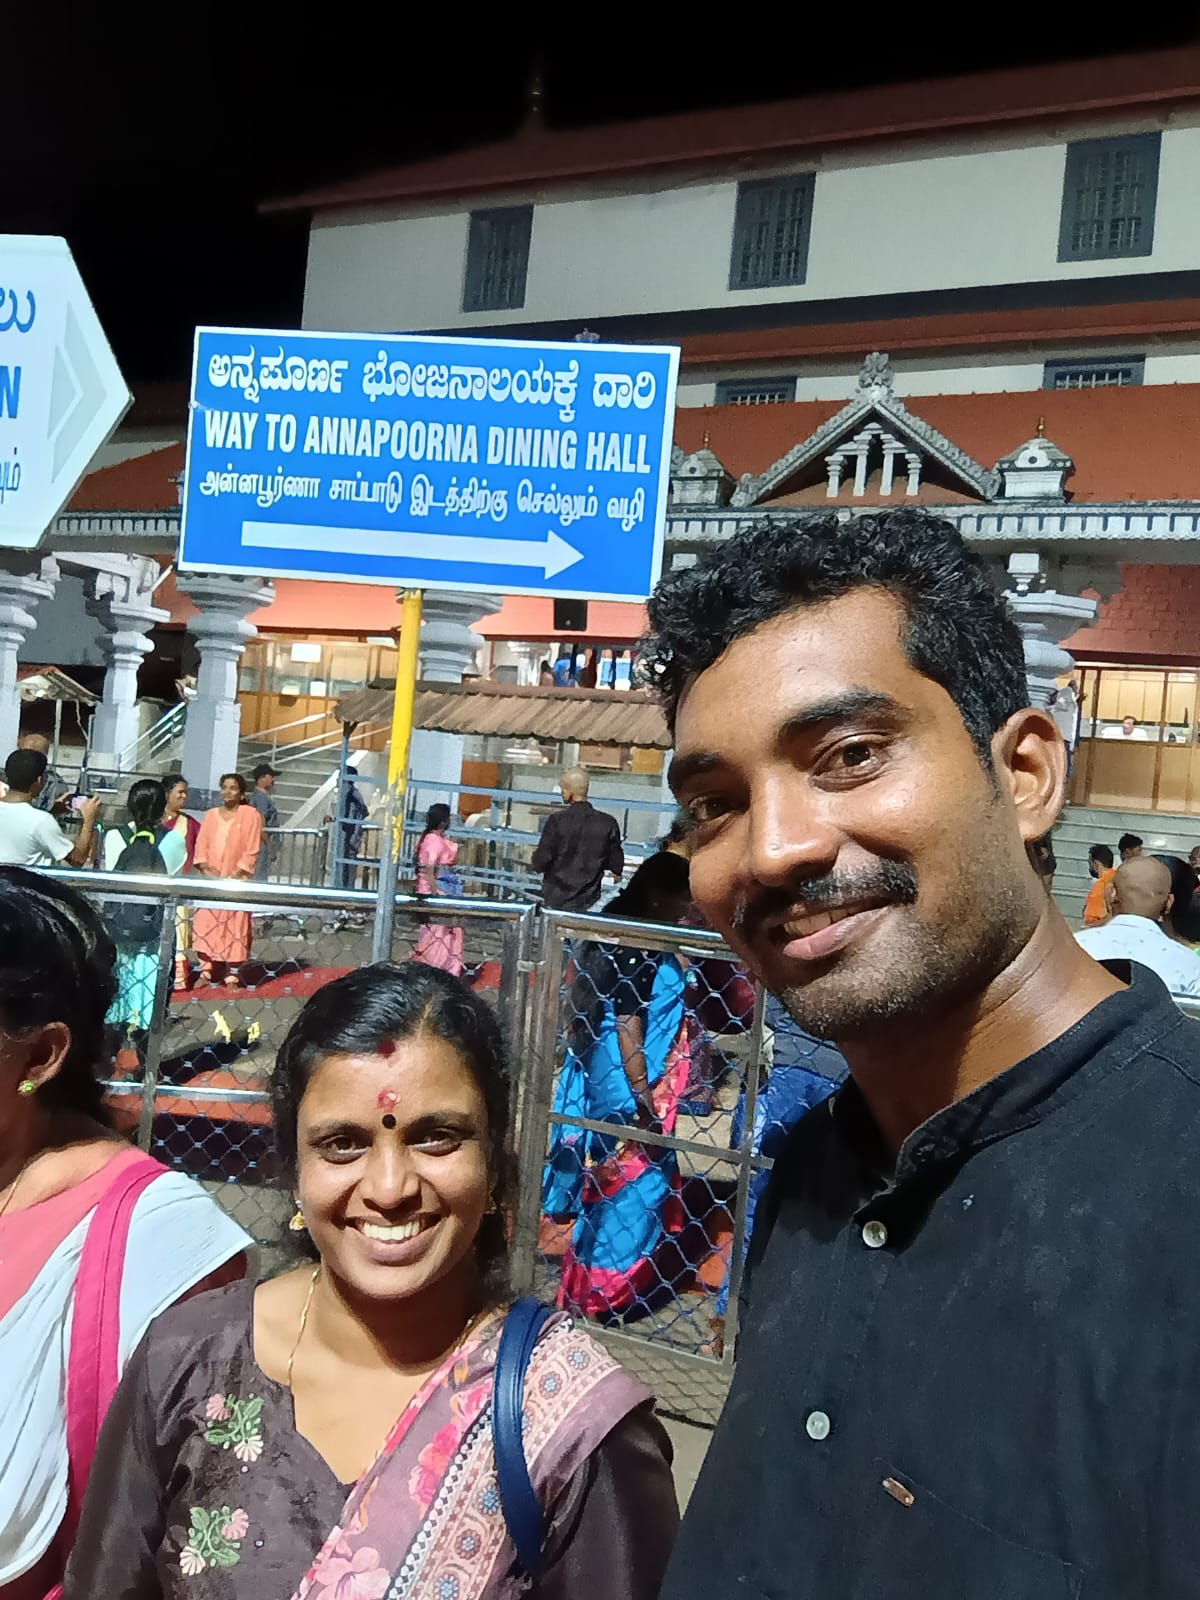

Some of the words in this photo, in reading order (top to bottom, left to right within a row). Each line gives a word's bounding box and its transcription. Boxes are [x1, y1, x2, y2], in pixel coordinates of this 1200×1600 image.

[208, 345, 349, 404] ಅನ್ನಪೂರ್ಣ
[362, 350, 579, 423] ಭೋಜನಾಲಯಕ್ಕೆ
[592, 371, 656, 410] ದಾರಿ
[204, 410, 259, 450] WAY
[265, 413, 297, 453] TO
[303, 416, 478, 464] ANNAPOORNA
[486, 426, 578, 470] DINING
[585, 431, 651, 474] HALL
[199, 463, 321, 508] அன்னபூர்ணா
[328, 470, 403, 514] சாப்பாடு
[409, 473, 508, 522] இடத்திற்கு
[516, 478, 598, 527] செல்லும்
[606, 487, 645, 532] வழி
